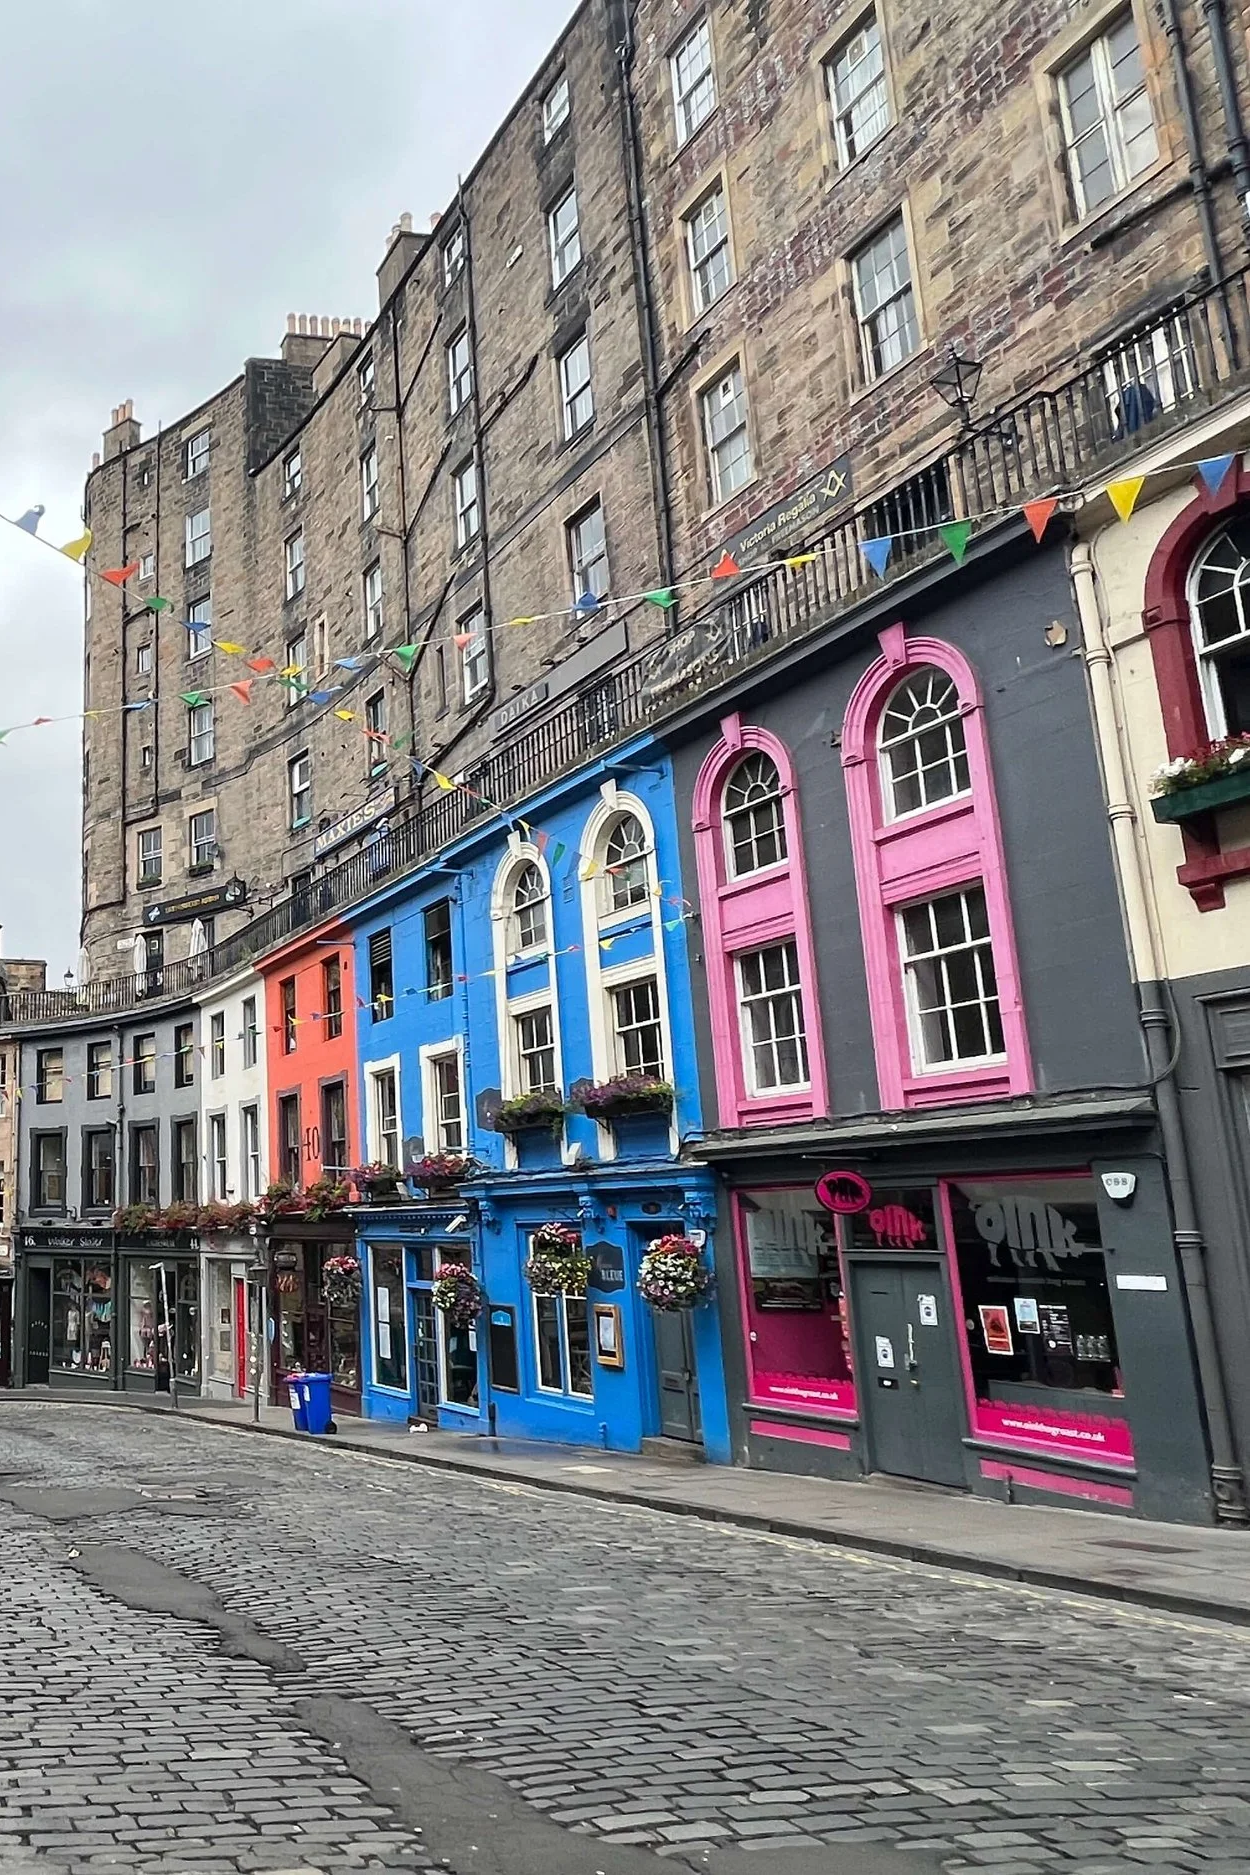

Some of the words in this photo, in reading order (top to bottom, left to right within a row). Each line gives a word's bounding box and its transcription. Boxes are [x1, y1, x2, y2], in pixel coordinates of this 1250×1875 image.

[740, 521, 777, 552] Victoria
[777, 493, 816, 527] Regalia
[668, 630, 696, 657] SHOP
[601, 1269, 624, 1282] BLEUE
